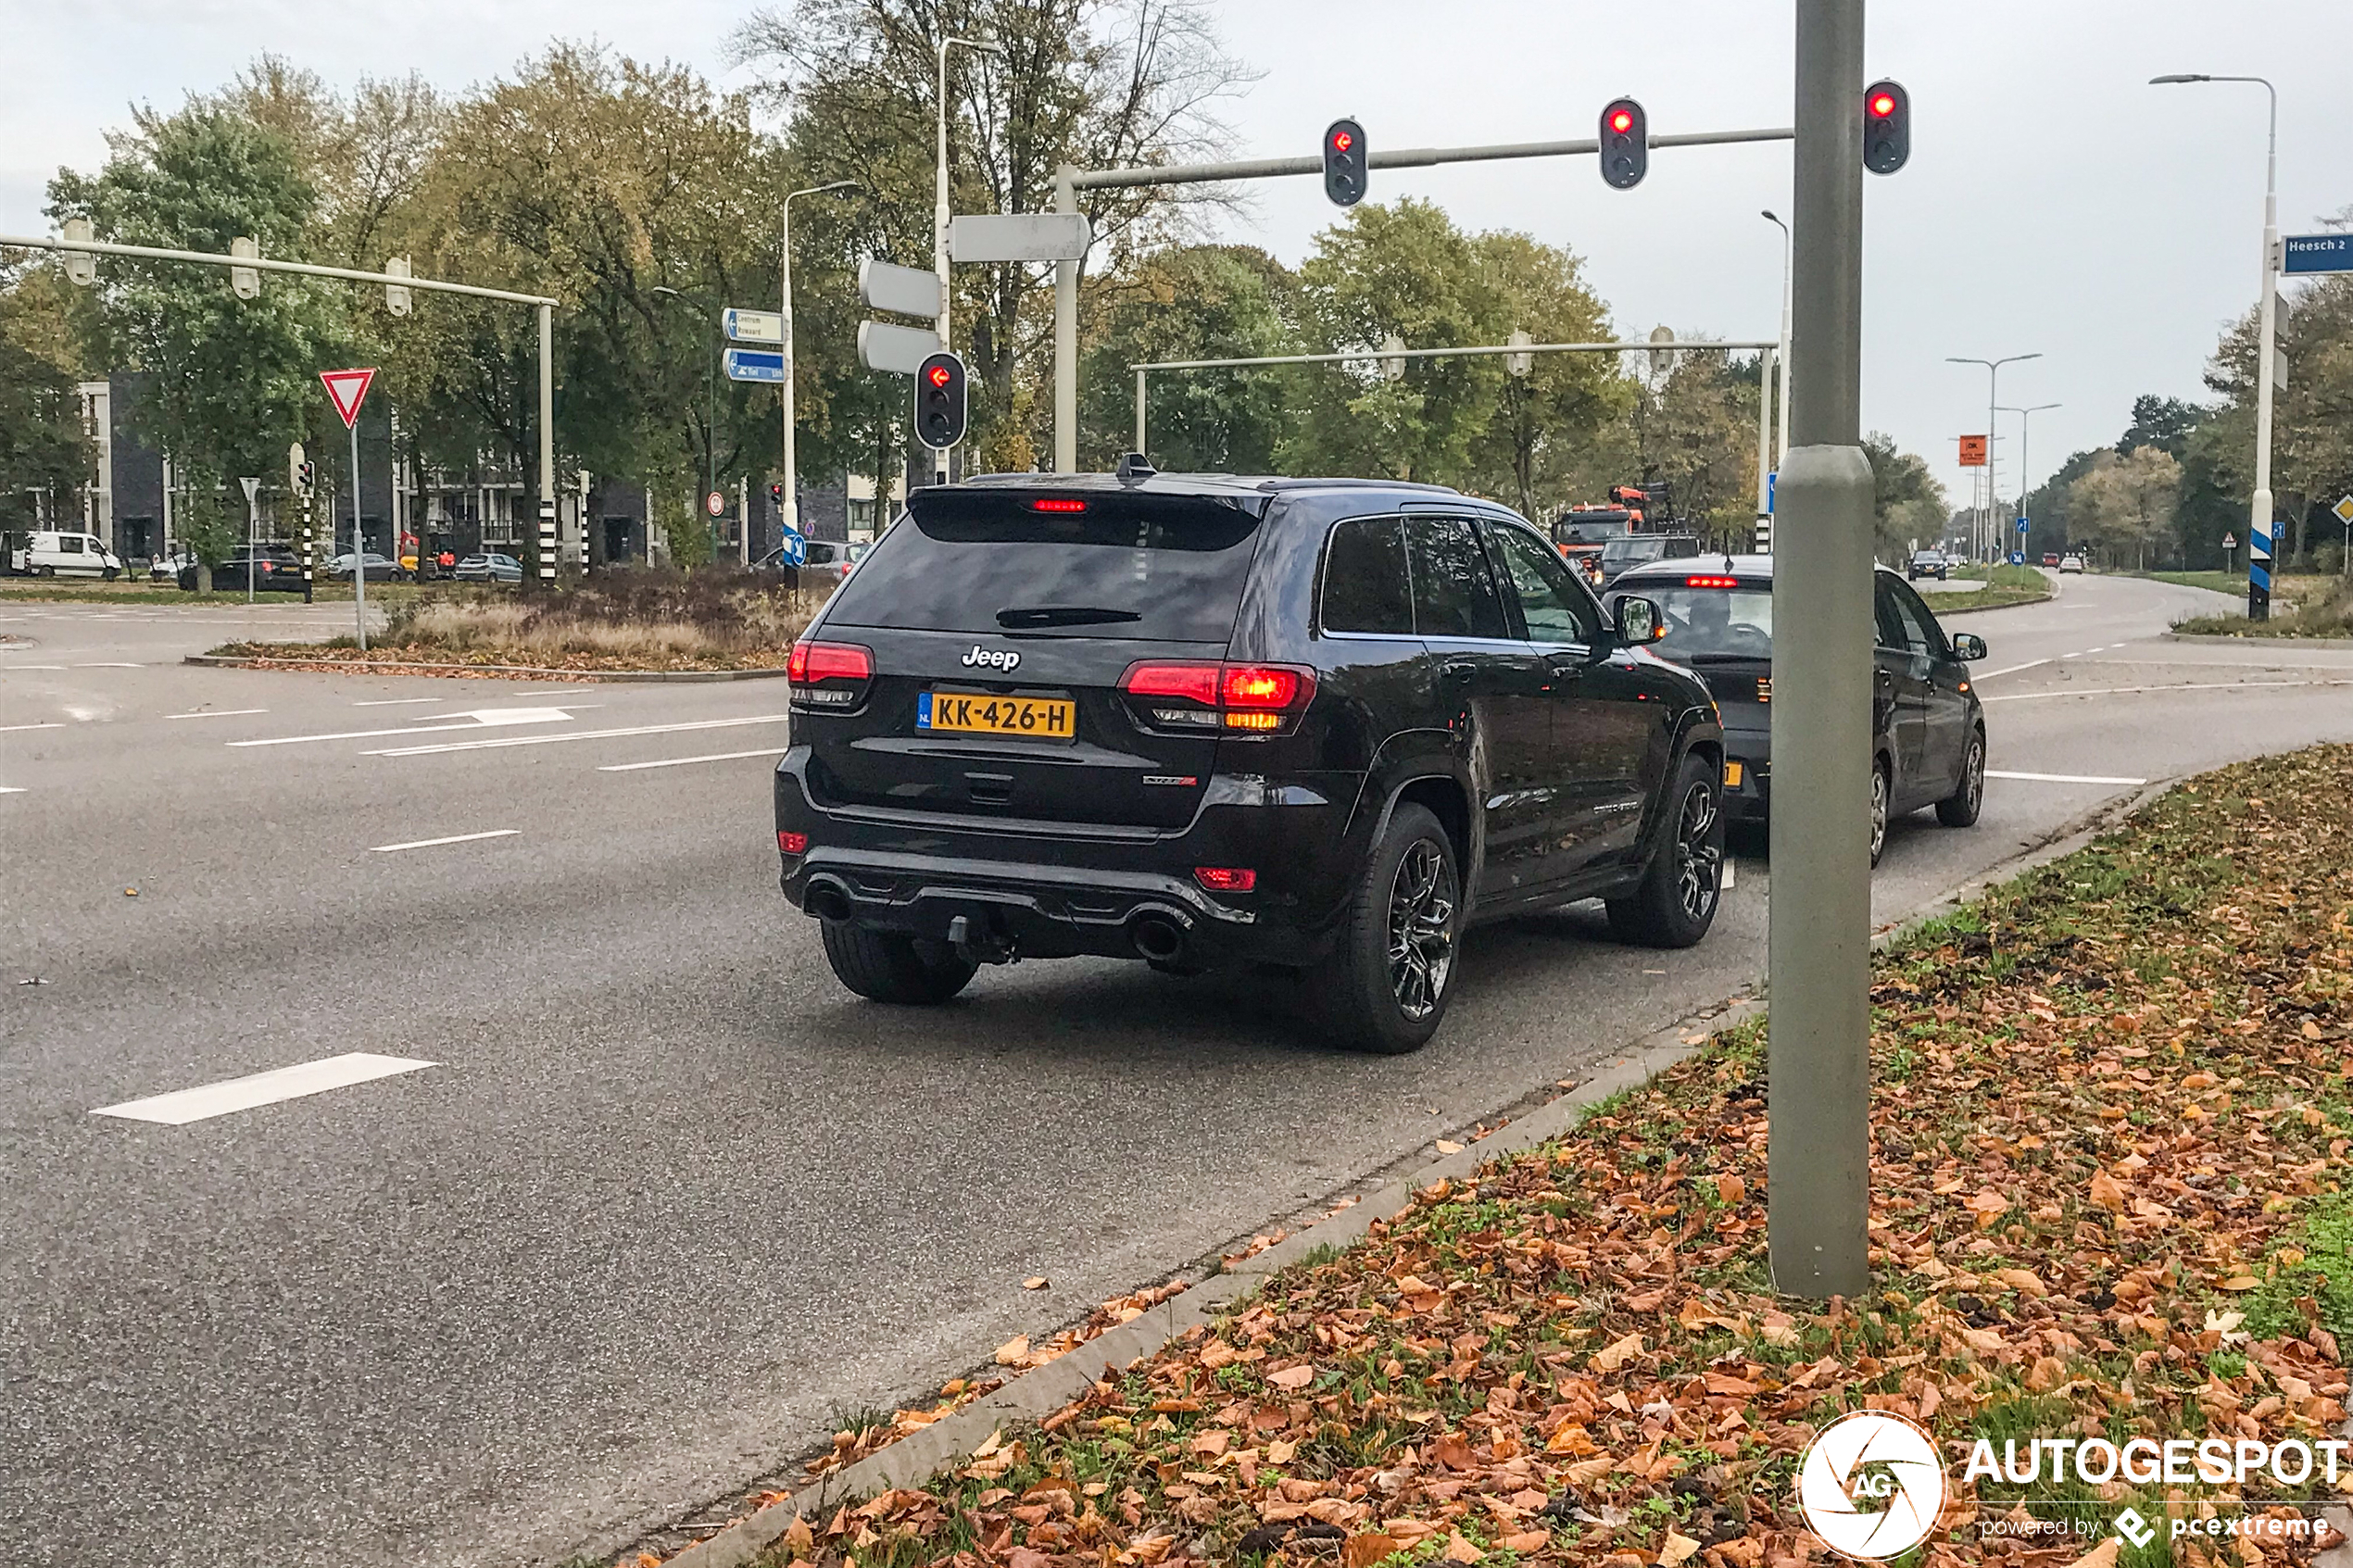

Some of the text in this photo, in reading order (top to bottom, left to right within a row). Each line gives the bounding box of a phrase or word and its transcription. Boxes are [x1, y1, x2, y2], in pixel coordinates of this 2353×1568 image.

[2289, 240, 2346, 252] Heesch 2
[962, 646, 1020, 671] Jeep
[919, 698, 1065, 732] NL KK-426-H
